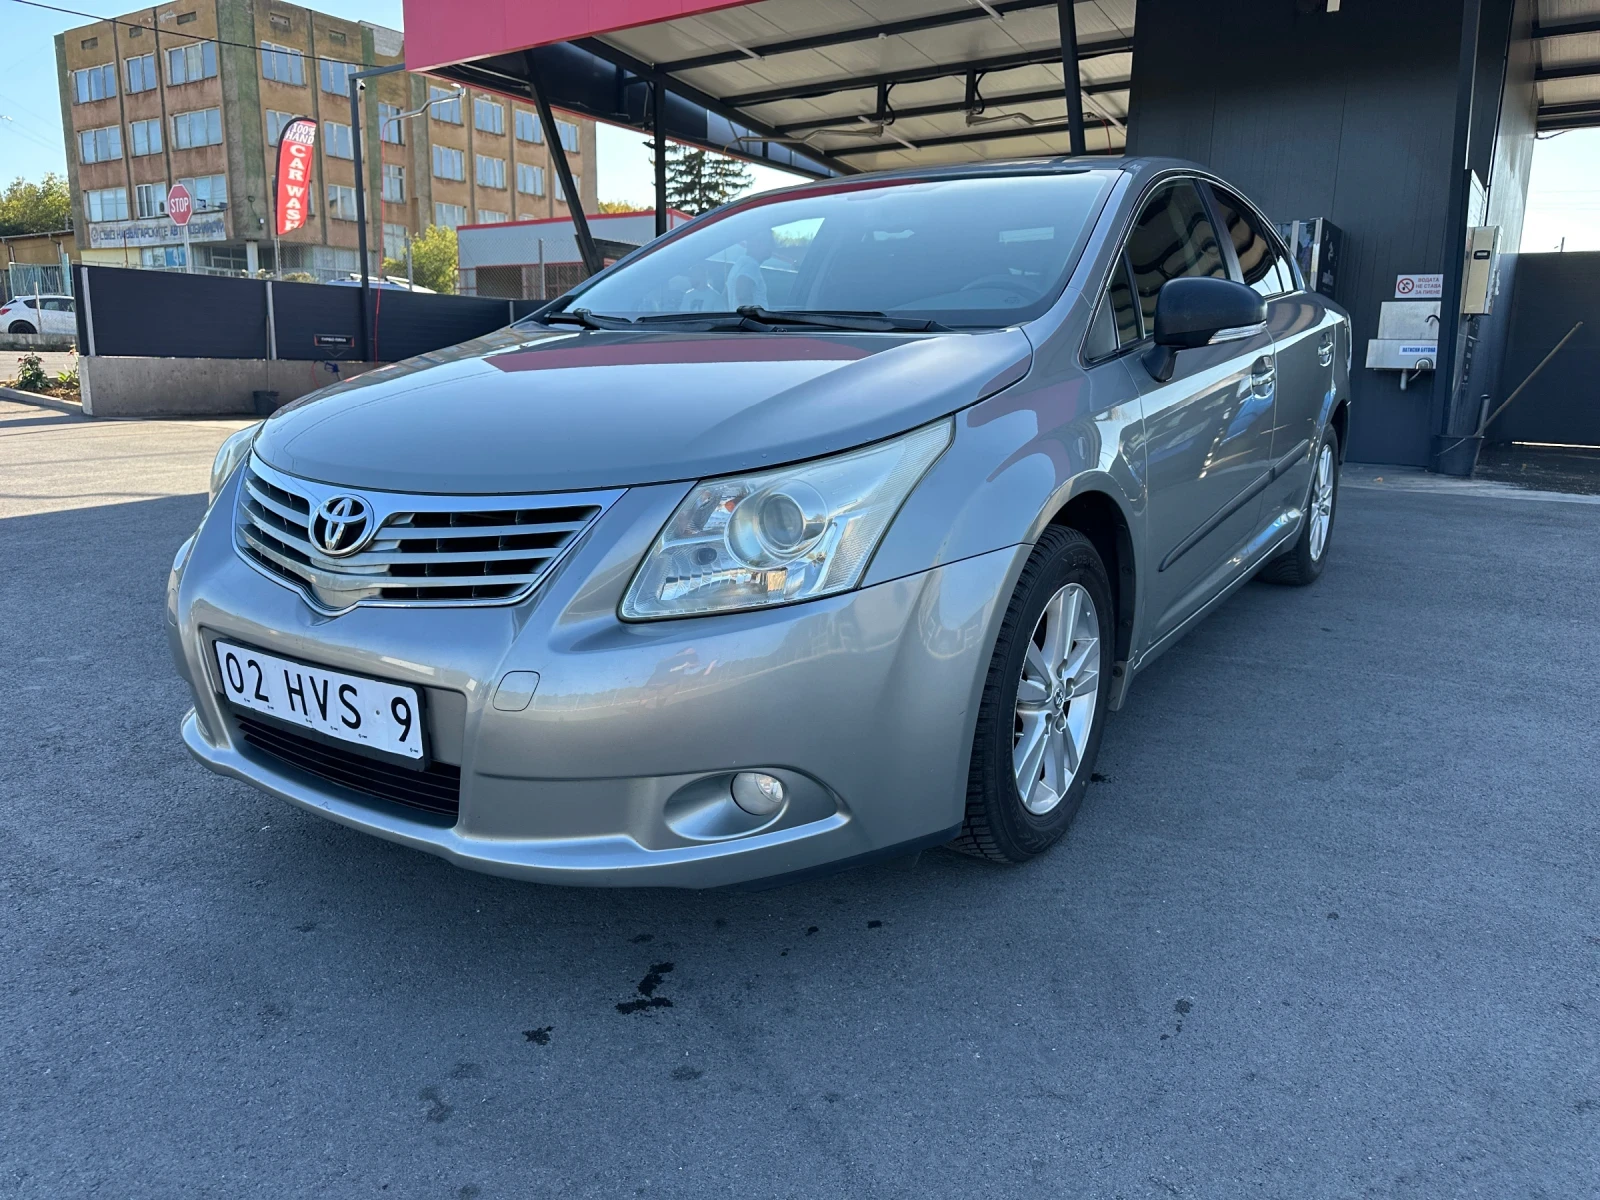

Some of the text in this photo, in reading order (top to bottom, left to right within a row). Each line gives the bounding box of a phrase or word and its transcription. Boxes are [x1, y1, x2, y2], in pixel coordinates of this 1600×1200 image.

[286, 130, 314, 144] HAND
[292, 123, 315, 136] 100%
[284, 144, 306, 231] CAR WASH
[170, 198, 189, 213] STOP
[225, 652, 412, 743] 02 HVS 9
